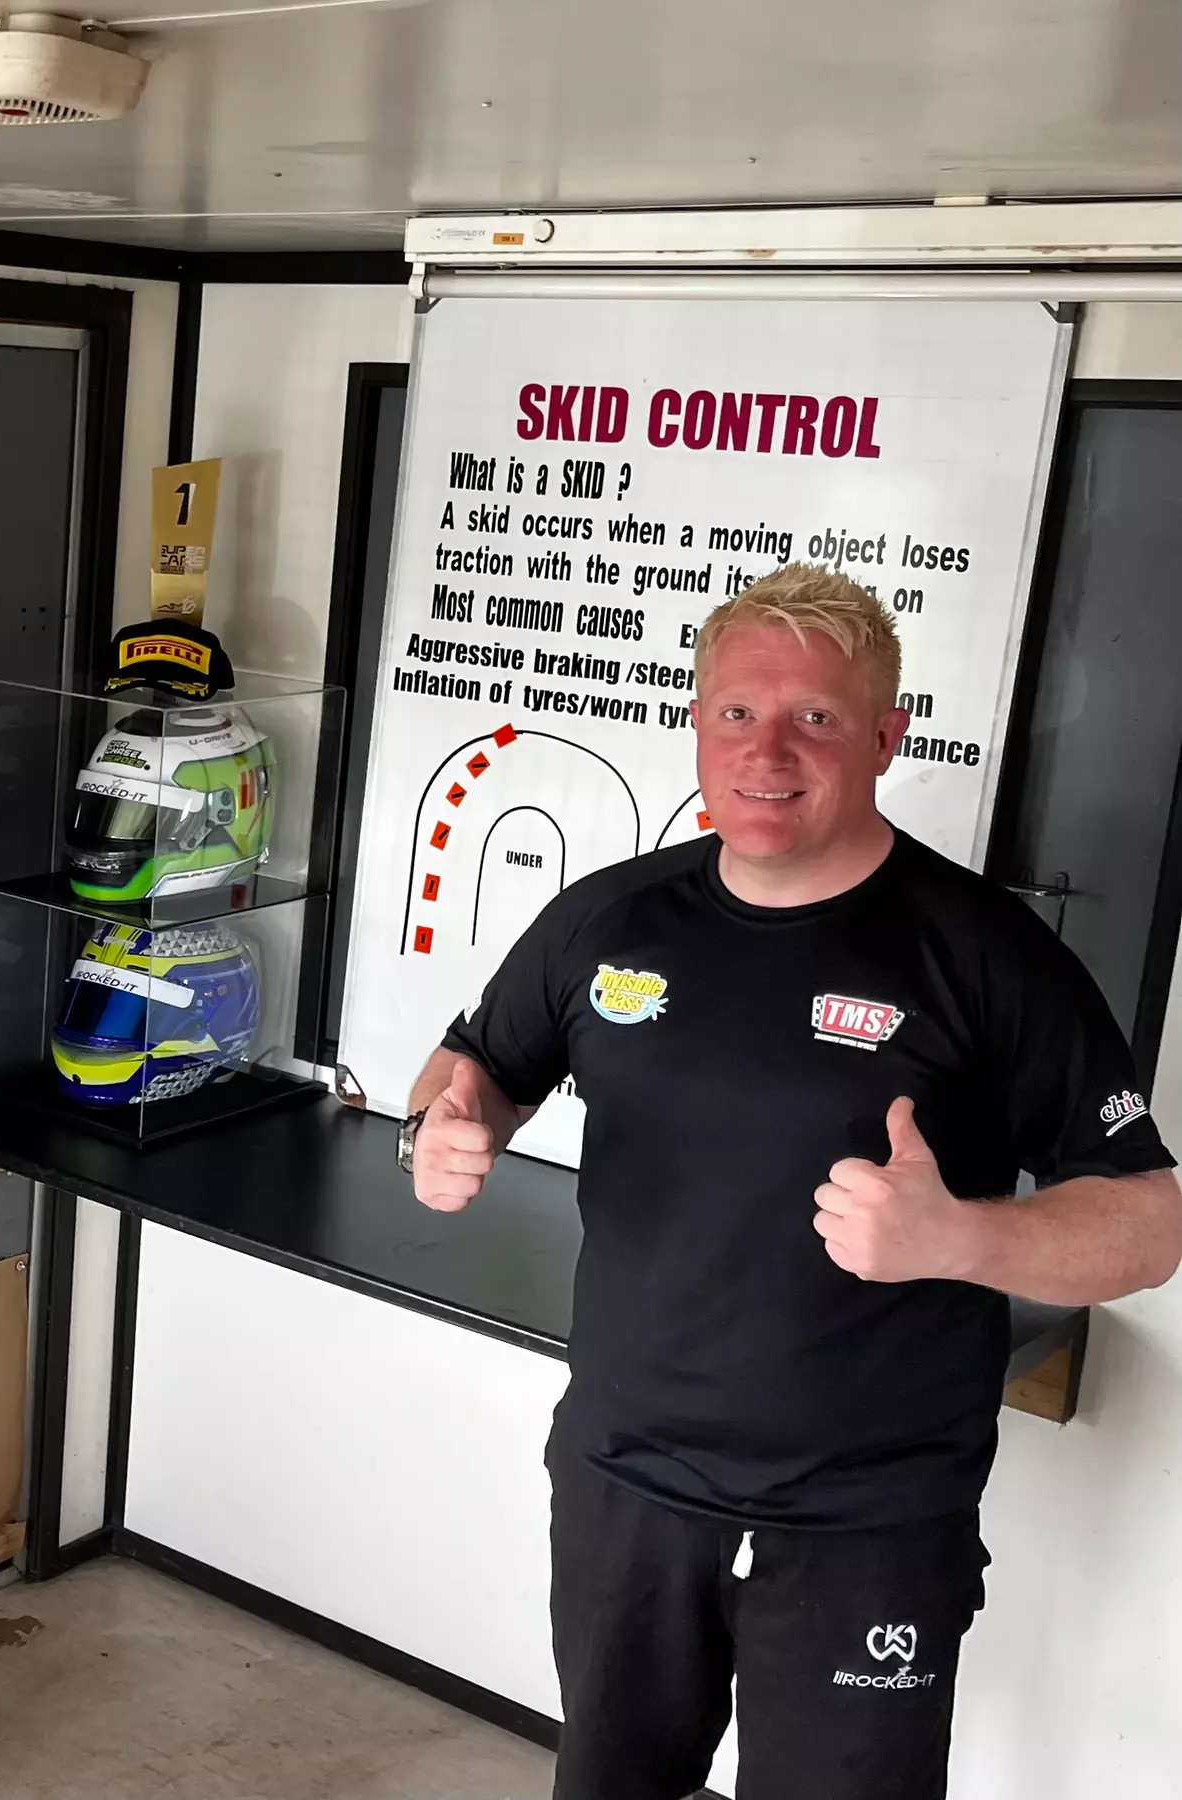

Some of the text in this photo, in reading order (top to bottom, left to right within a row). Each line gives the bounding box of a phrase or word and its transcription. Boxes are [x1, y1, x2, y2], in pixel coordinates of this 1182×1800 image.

[517, 383, 882, 459] SKID CONTROL
[449, 451, 631, 501] What is a SKID ?
[175, 483, 197, 526] 1
[440, 501, 970, 573] A skid occurs when a moving object loses
[435, 542, 513, 576] traction
[526, 550, 572, 581] with
[586, 554, 620, 585] the
[633, 564, 712, 596] ground
[893, 586, 924, 614] on
[431, 584, 475, 623] Most
[485, 595, 564, 633] common
[576, 604, 645, 642] causes
[126, 640, 203, 666] PIRELLI
[406, 633, 525, 671] Aggressive
[533, 648, 621, 685] braking
[393, 667, 697, 730] Inflation of tyres/worn tyr
[894, 734, 981, 767] nance
[506, 850, 543, 868] UNDER
[598, 966, 665, 997] Invisible
[601, 988, 644, 1013] Glass
[826, 1001, 885, 1034] TMS
